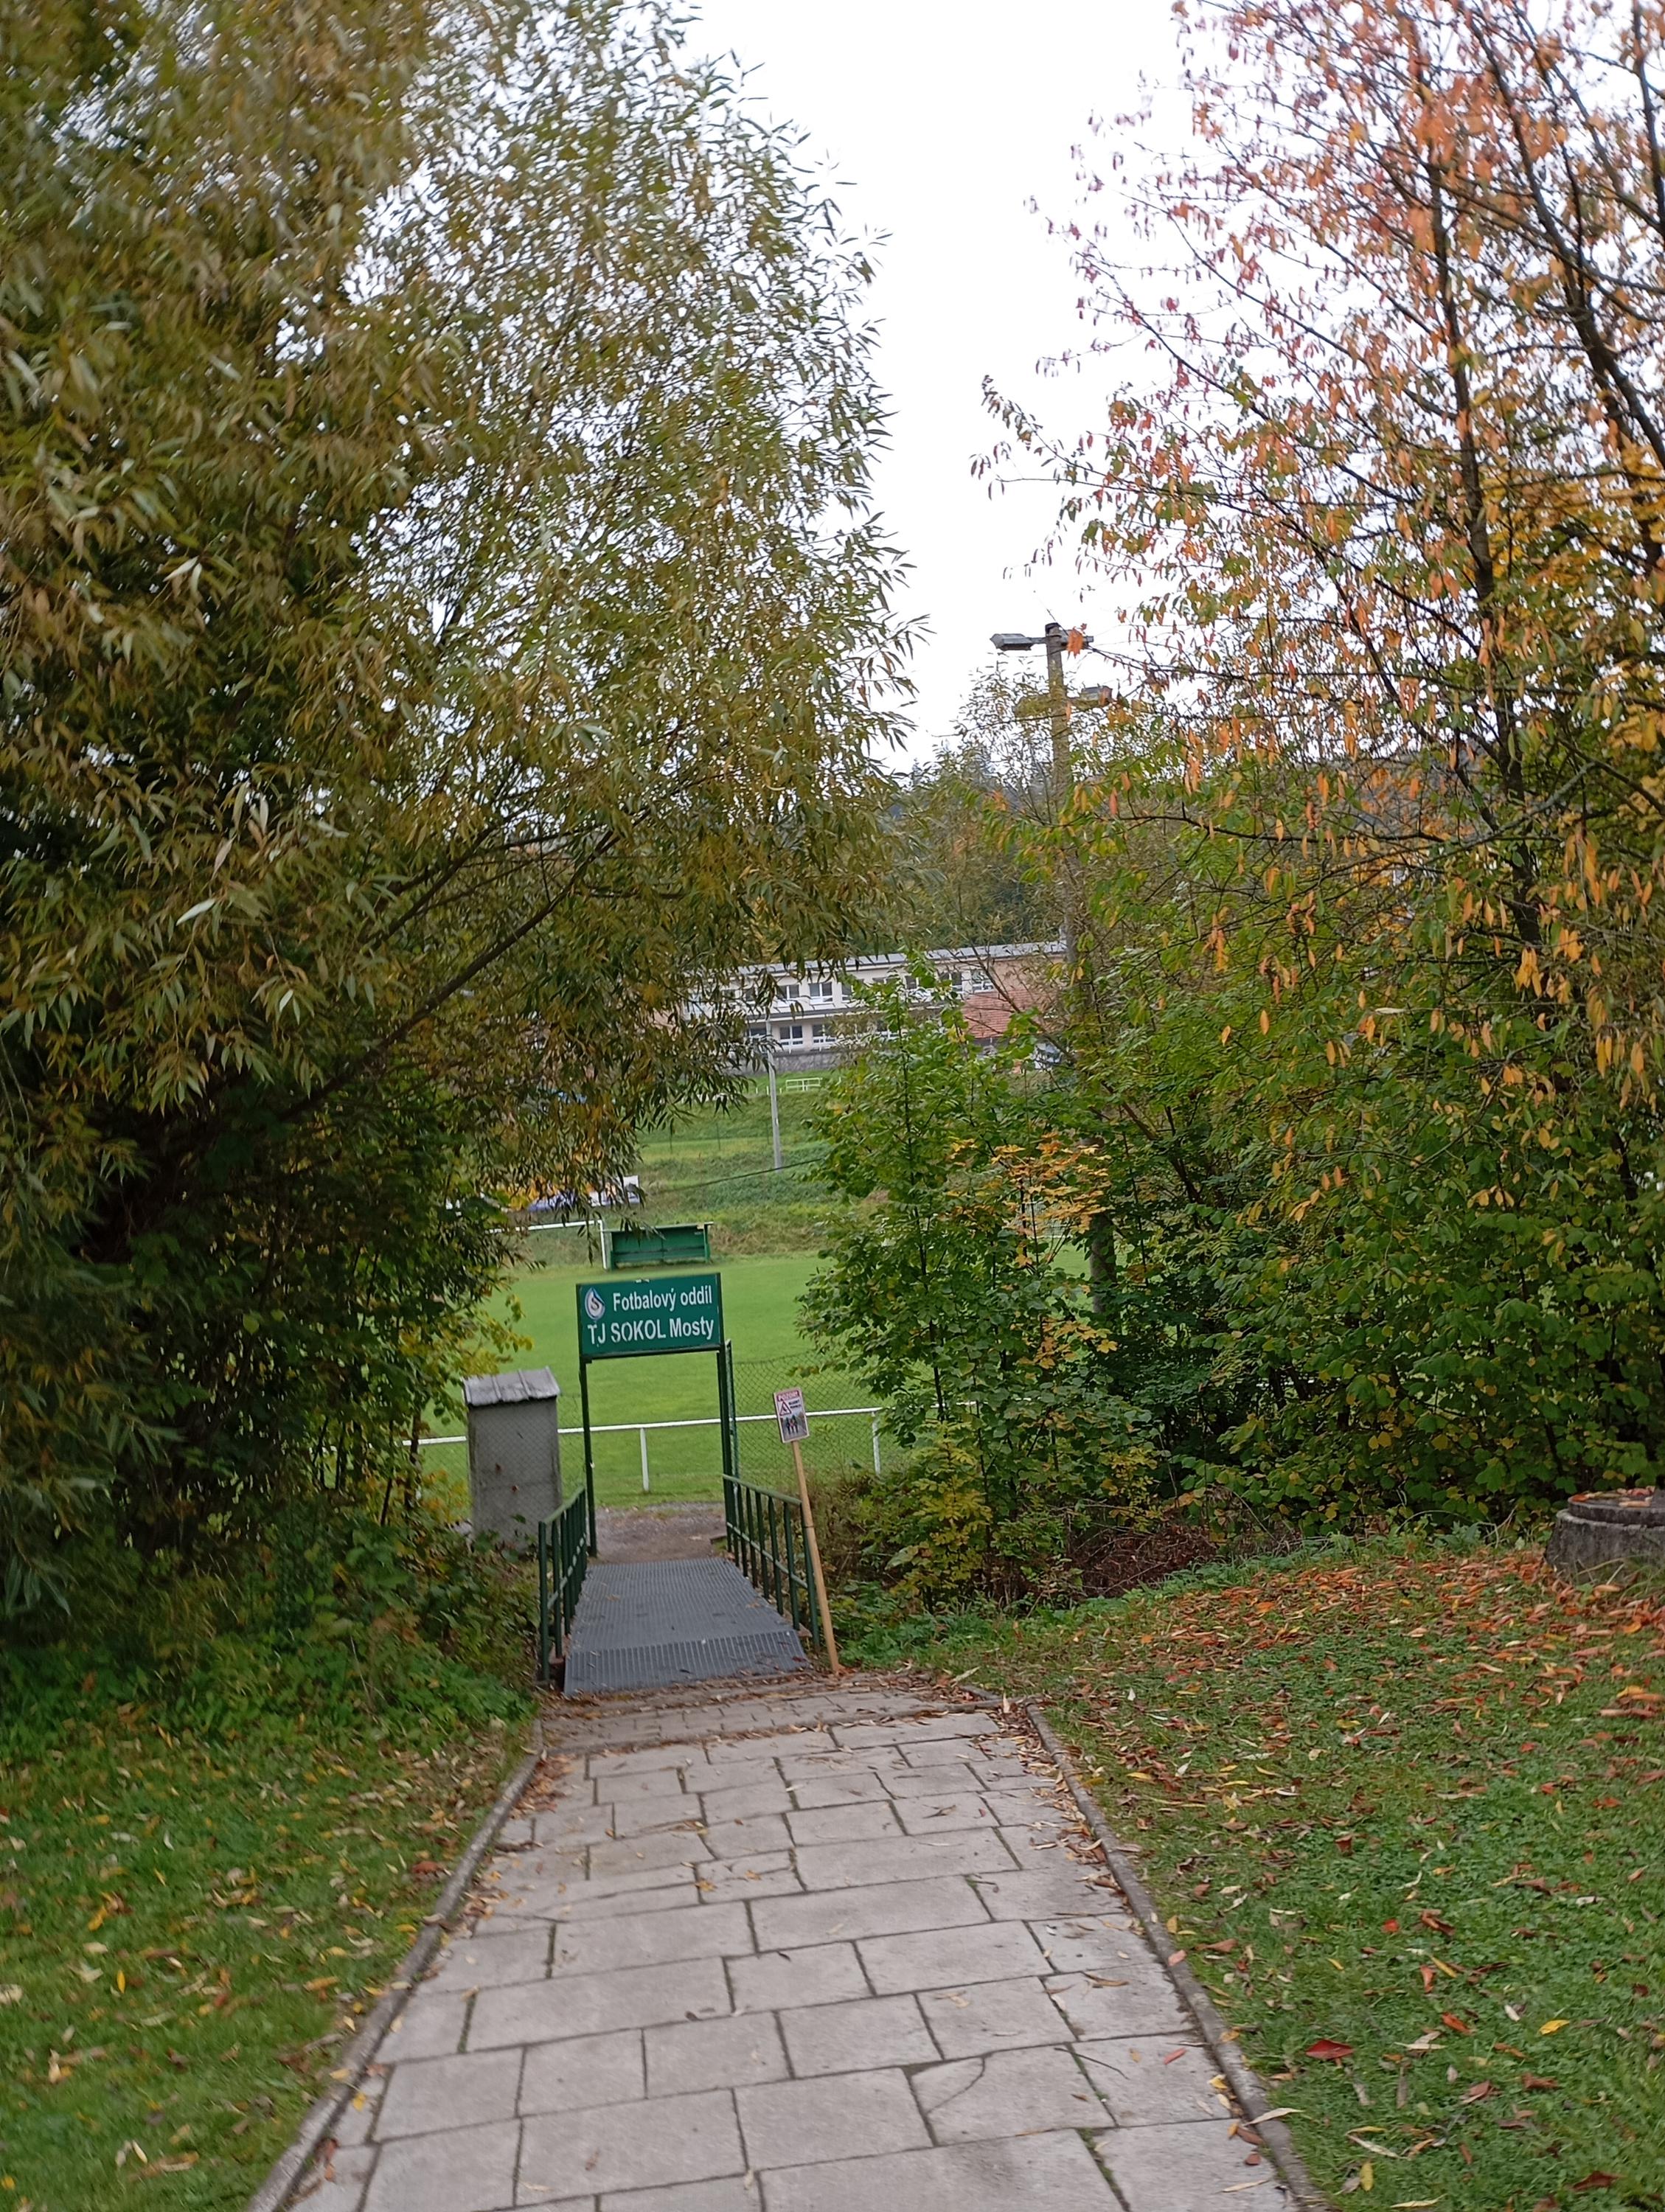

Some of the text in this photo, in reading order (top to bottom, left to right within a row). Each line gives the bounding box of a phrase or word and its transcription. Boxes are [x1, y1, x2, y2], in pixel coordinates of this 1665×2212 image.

[613, 1284, 713, 1312] Fotbalový oddíl
[588, 1316, 714, 1345] TJ SOKOL Mosty
